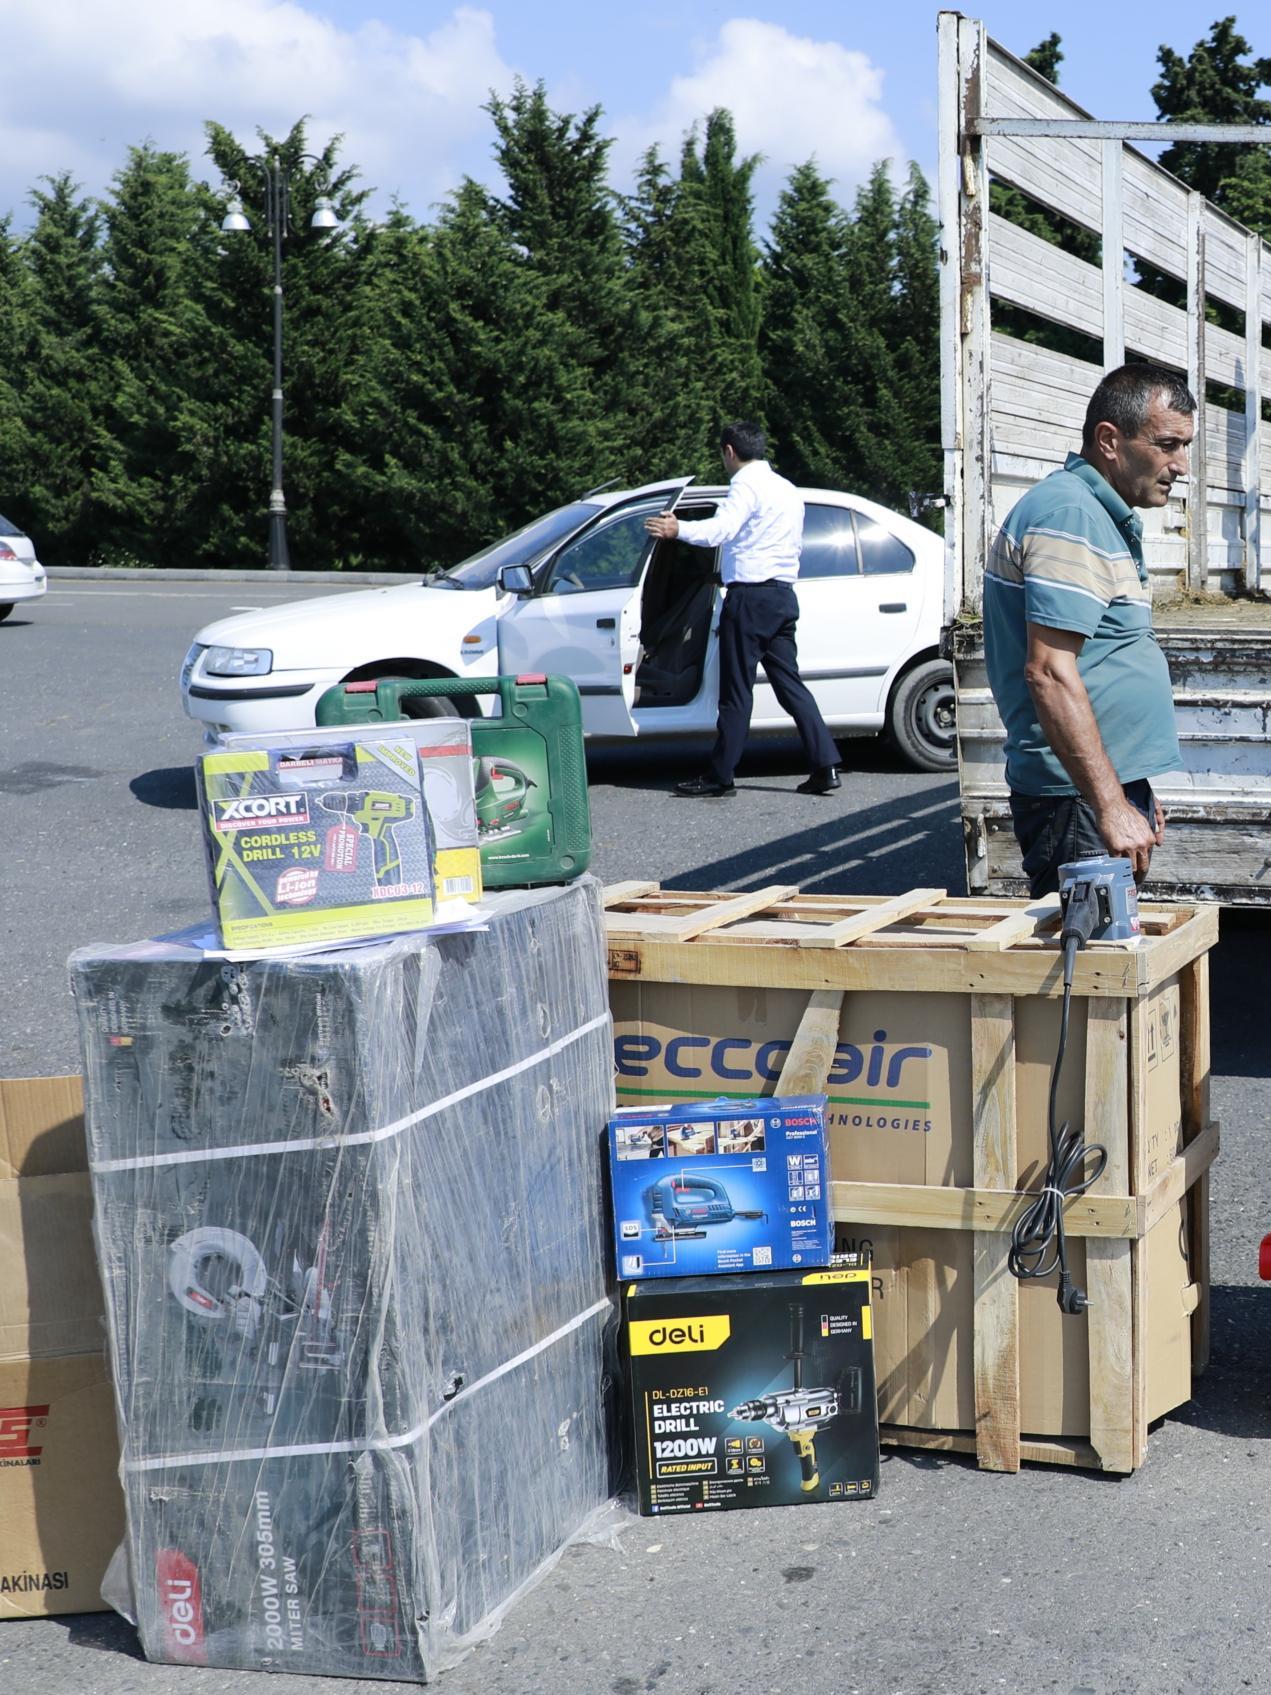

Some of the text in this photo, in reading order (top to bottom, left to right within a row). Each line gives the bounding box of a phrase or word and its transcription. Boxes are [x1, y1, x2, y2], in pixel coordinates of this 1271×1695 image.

[378, 745, 415, 777] IMPROVED
[220, 795, 302, 821] XCORT
[220, 815, 304, 829] DISCOVER YOUR POWER
[240, 831, 316, 848] CORDLESS
[335, 829, 346, 869] PROMOTION
[343, 833, 355, 866] SPECIAL
[243, 847, 284, 862] DRILL
[291, 844, 321, 859] 12V
[277, 879, 316, 893] Li-ion
[785, 1118, 817, 1127] BOSCH
[649, 1324, 704, 1346] deli
[652, 1386, 709, 1400] DL-DZ16-E1
[653, 1399, 725, 1418] ELECTRIC
[654, 1418, 700, 1434] DRILL
[653, 1437, 717, 1458] 1200W
[661, 1462, 713, 1474] RATED INPUT
[255, 1489, 284, 1651] 2000W 305mm
[167, 1579, 196, 1646] deli
[282, 1556, 305, 1651] MITER SAW
